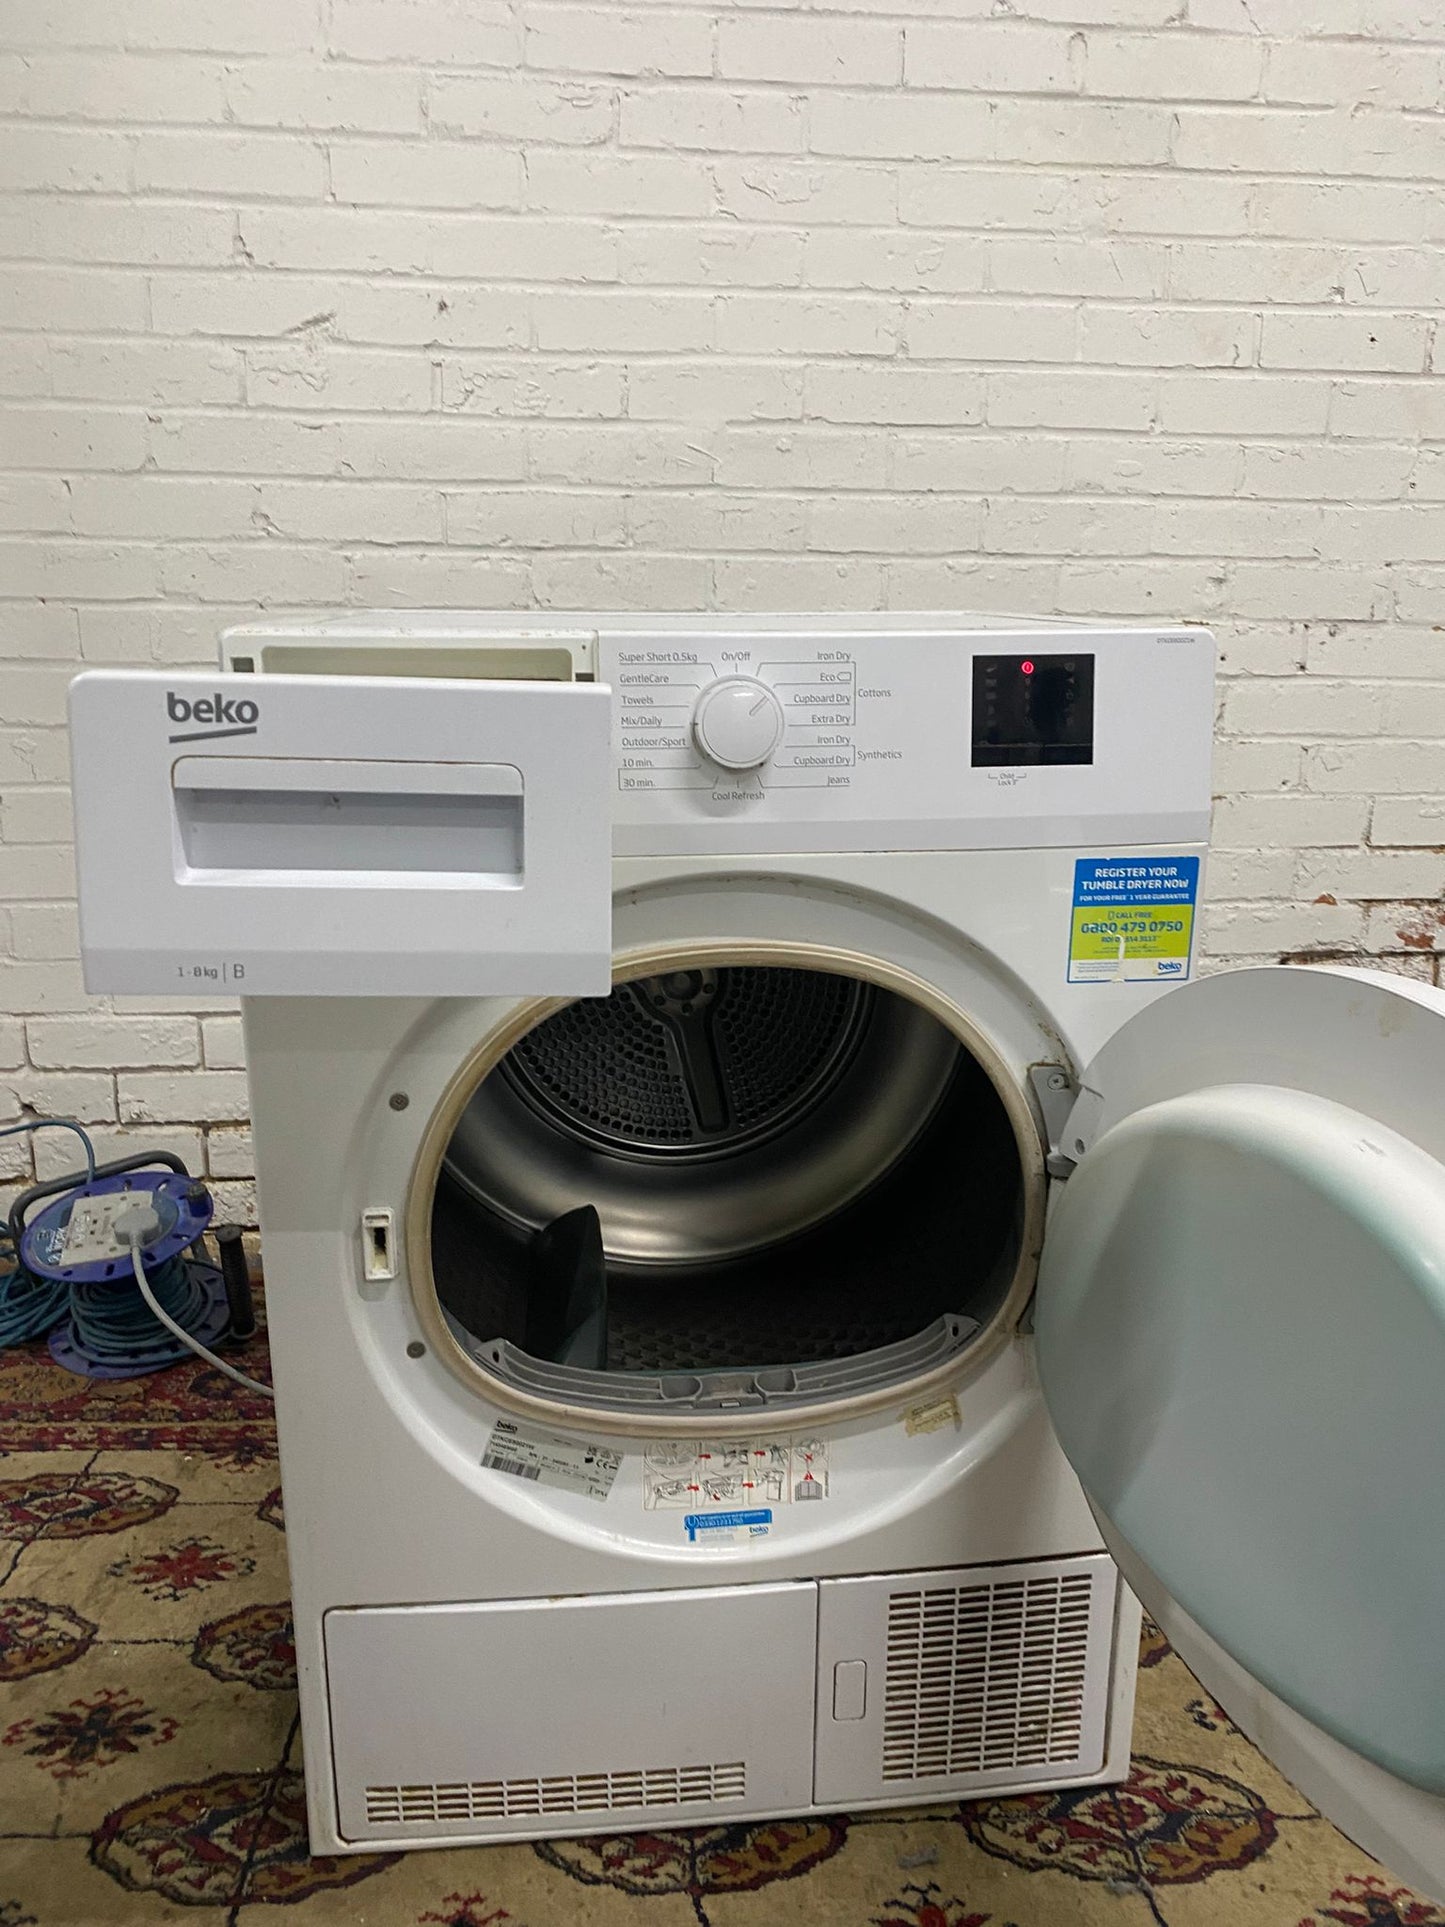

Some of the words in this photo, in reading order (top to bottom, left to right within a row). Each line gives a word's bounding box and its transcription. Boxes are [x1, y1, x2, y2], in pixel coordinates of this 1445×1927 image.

[618, 652, 645, 662] Super
[647, 652, 671, 662] Short
[672, 652, 698, 663] 0.5kg
[721, 652, 751, 662] On/Off
[817, 652, 834, 660] Iron
[836, 651, 851, 662] Dry
[619, 673, 670, 683] GentleCare
[820, 672, 836, 682] Eco
[857, 688, 892, 698] Cottons
[621, 695, 654, 705] Towels
[793, 694, 835, 705] Cupboard
[836, 693, 851, 704] Dry
[166, 692, 260, 724] beko
[621, 716, 662, 727] Mix/Daily
[811, 715, 835, 724] Extra
[836, 714, 851, 725] Dry
[621, 737, 687, 749] Outdoor/Sport
[817, 736, 834, 744] Iron
[836, 735, 851, 746] Dry
[793, 756, 835, 767] Cupboard
[836, 755, 851, 766] Dry
[857, 750, 903, 761] Synthetics
[622, 758, 635, 768] 10
[635, 757, 655, 768] min.
[623, 778, 636, 788] 30
[636, 778, 656, 788] min.
[827, 775, 850, 787] Jeans
[711, 791, 731, 801] Cool
[731, 791, 766, 801] Refresh
[1095, 867, 1147, 878] REGISTER
[1148, 866, 1178, 877] YOUR
[1081, 880, 1126, 891] TUMBLE
[1127, 879, 1162, 890] DRYER
[1164, 878, 1190, 889] NOW
[1116, 911, 1133, 919] CALL
[1081, 921, 1118, 934] 0800
[1120, 922, 1147, 933] 479
[1149, 920, 1183, 932] 0750
[233, 963, 245, 979] B
[1157, 961, 1182, 971] beko
[749, 1525, 769, 1534] beko
